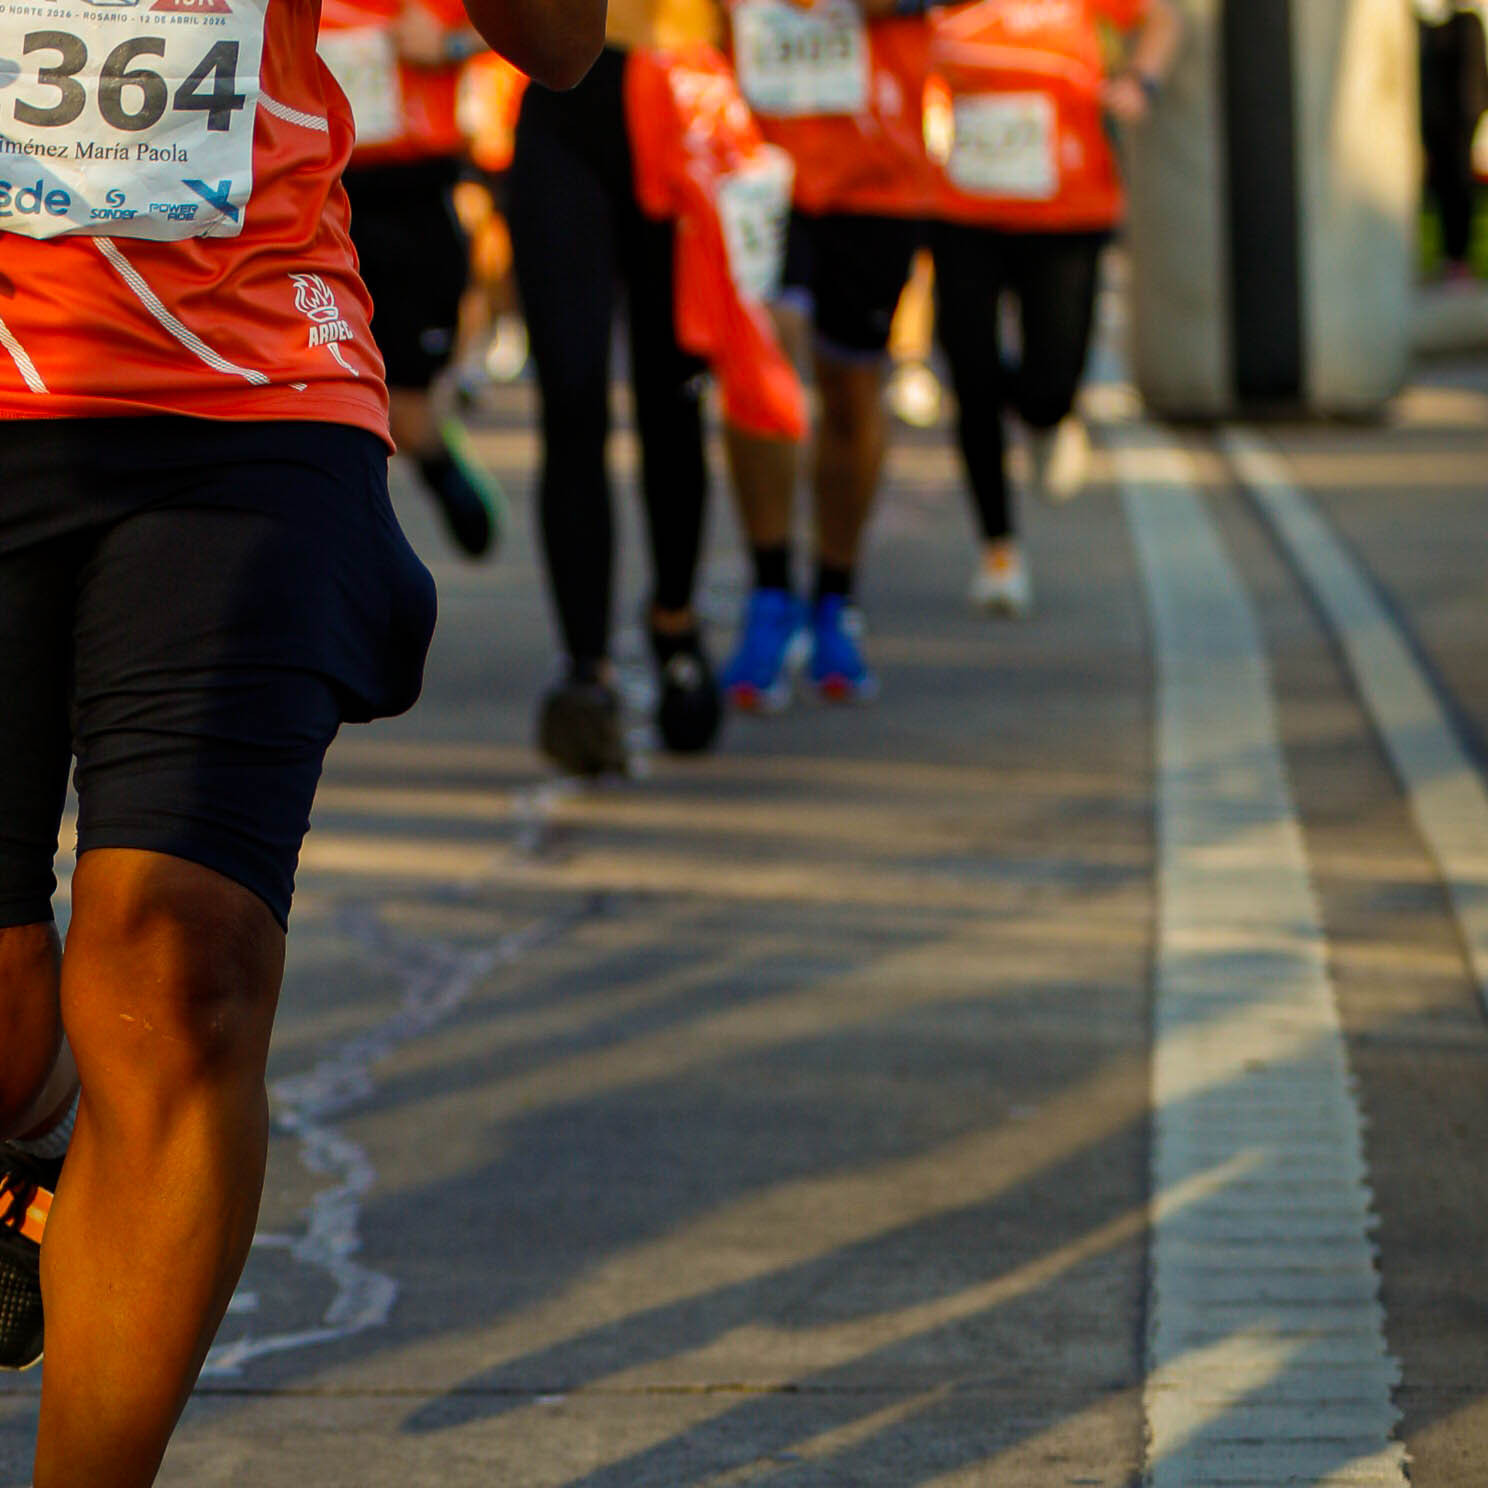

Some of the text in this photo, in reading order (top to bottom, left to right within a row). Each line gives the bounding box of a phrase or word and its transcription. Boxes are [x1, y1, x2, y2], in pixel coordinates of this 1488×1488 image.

[9, 6, 43, 17] NORTE
[47, 9, 72, 19] 2026
[83, 12, 128, 23] ROSARIO
[140, 15, 150, 24] 12
[155, 16, 166, 24] DE
[170, 16, 199, 25] ABRIL
[75, 141, 129, 161] María
[137, 143, 189, 162] Paola
